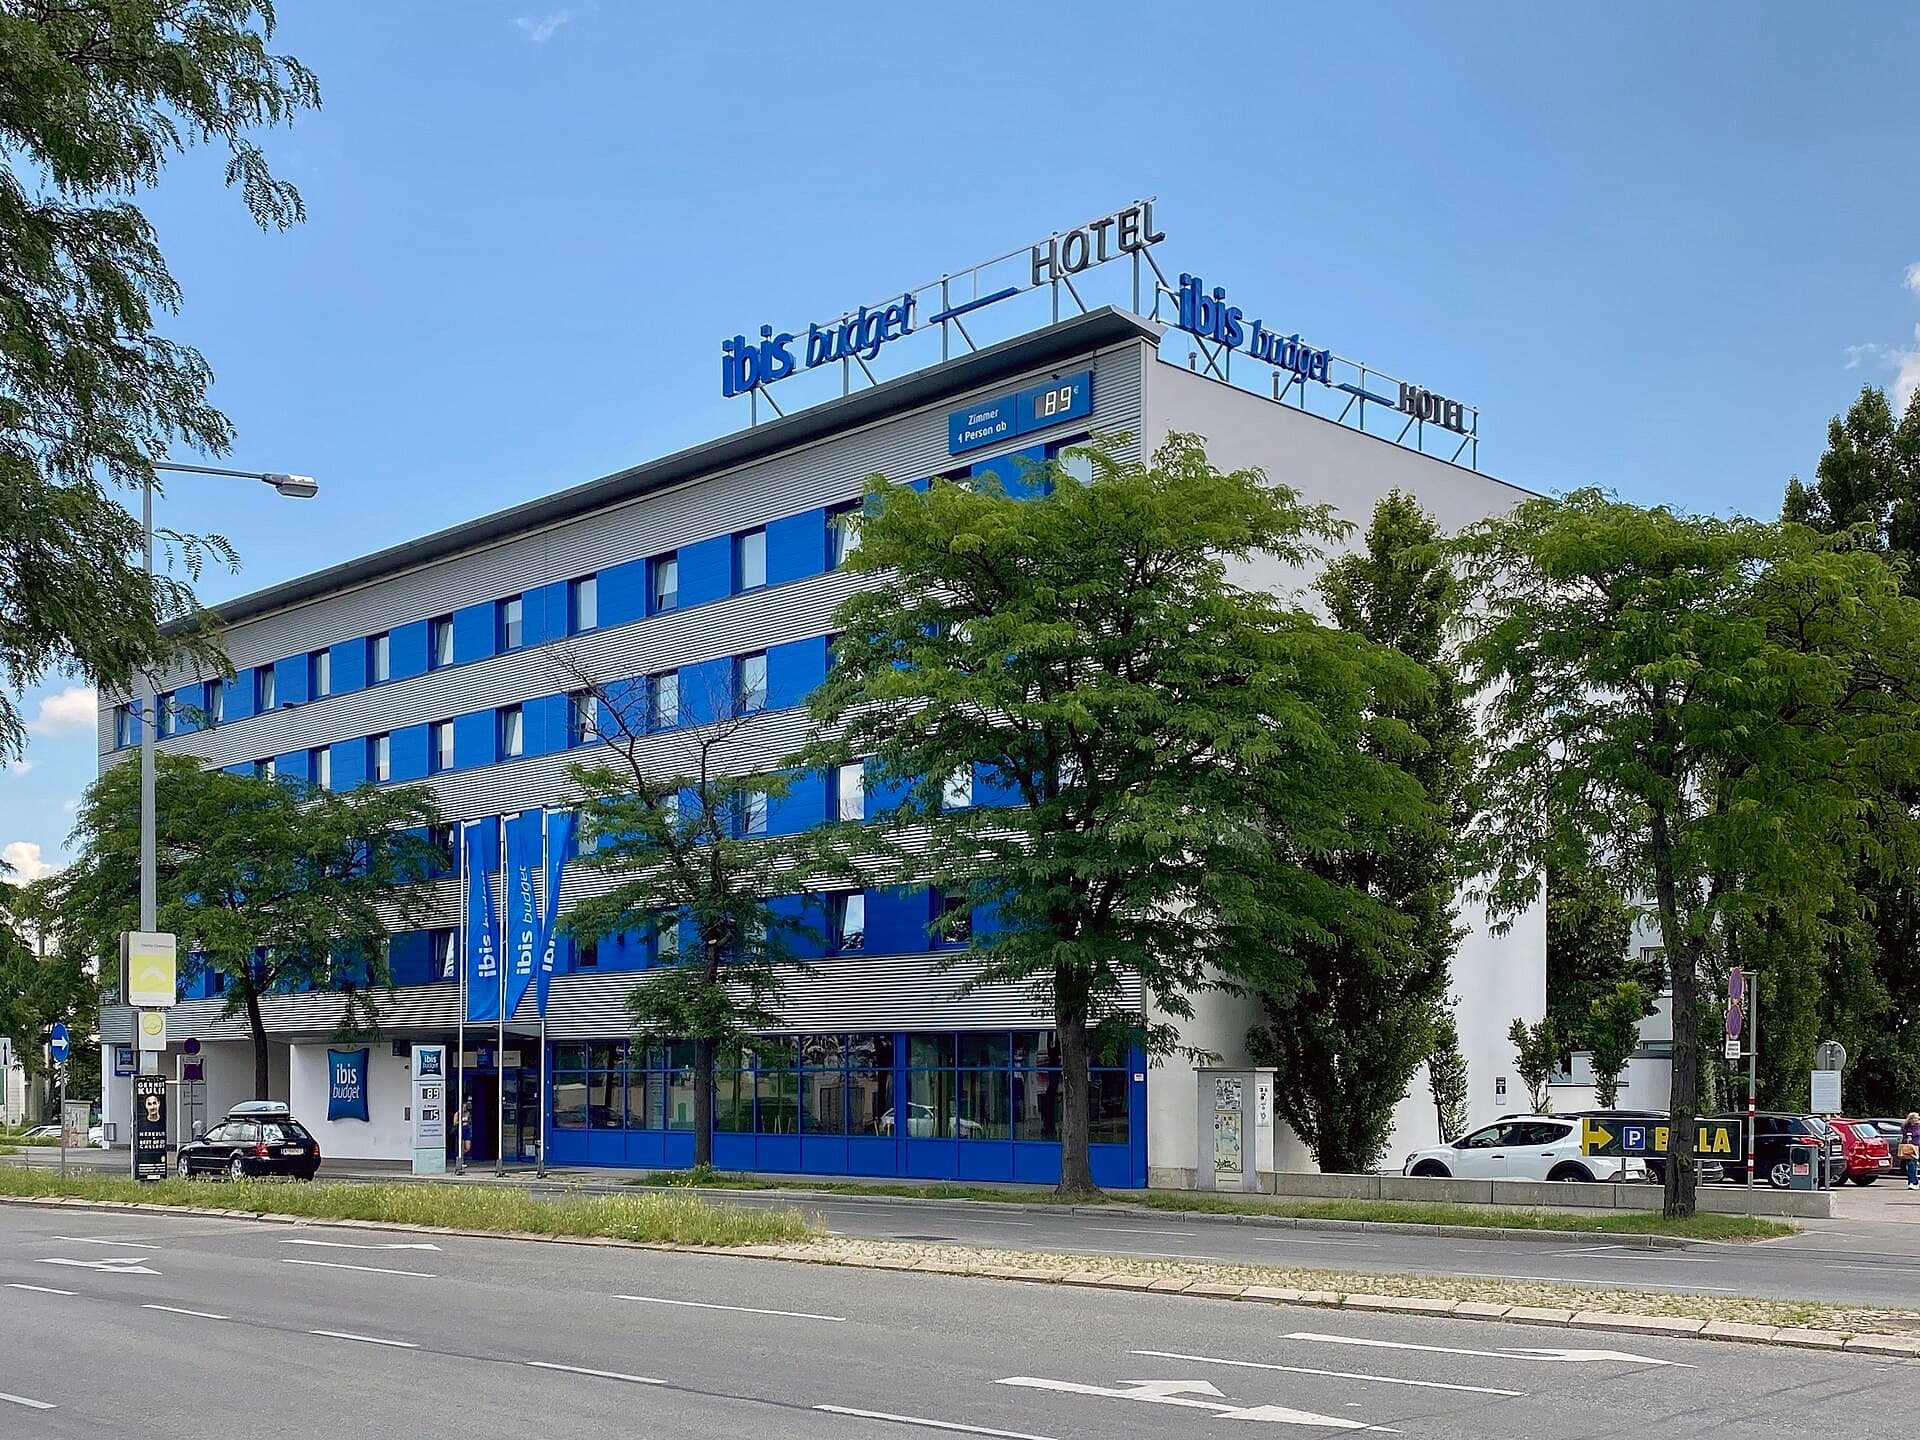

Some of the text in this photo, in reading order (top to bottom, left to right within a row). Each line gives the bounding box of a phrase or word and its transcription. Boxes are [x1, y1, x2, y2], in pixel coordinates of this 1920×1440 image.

[722, 202, 1166, 398] ibis budget HOTEL
[1179, 272, 1470, 435] ibis budget HOTEL
[968, 409, 999, 426] Zimmer
[965, 426, 993, 442] Person
[995, 420, 1007, 432] ab
[478, 935, 497, 978] ibis
[516, 930, 533, 975] ibis
[424, 1054, 437, 1063] ibis
[336, 1063, 357, 1084] ibis
[332, 1083, 361, 1103] budget
[427, 1088, 439, 1099] 89
[430, 1110, 439, 1121] 15
[1629, 1127, 1732, 1153] P BLA
